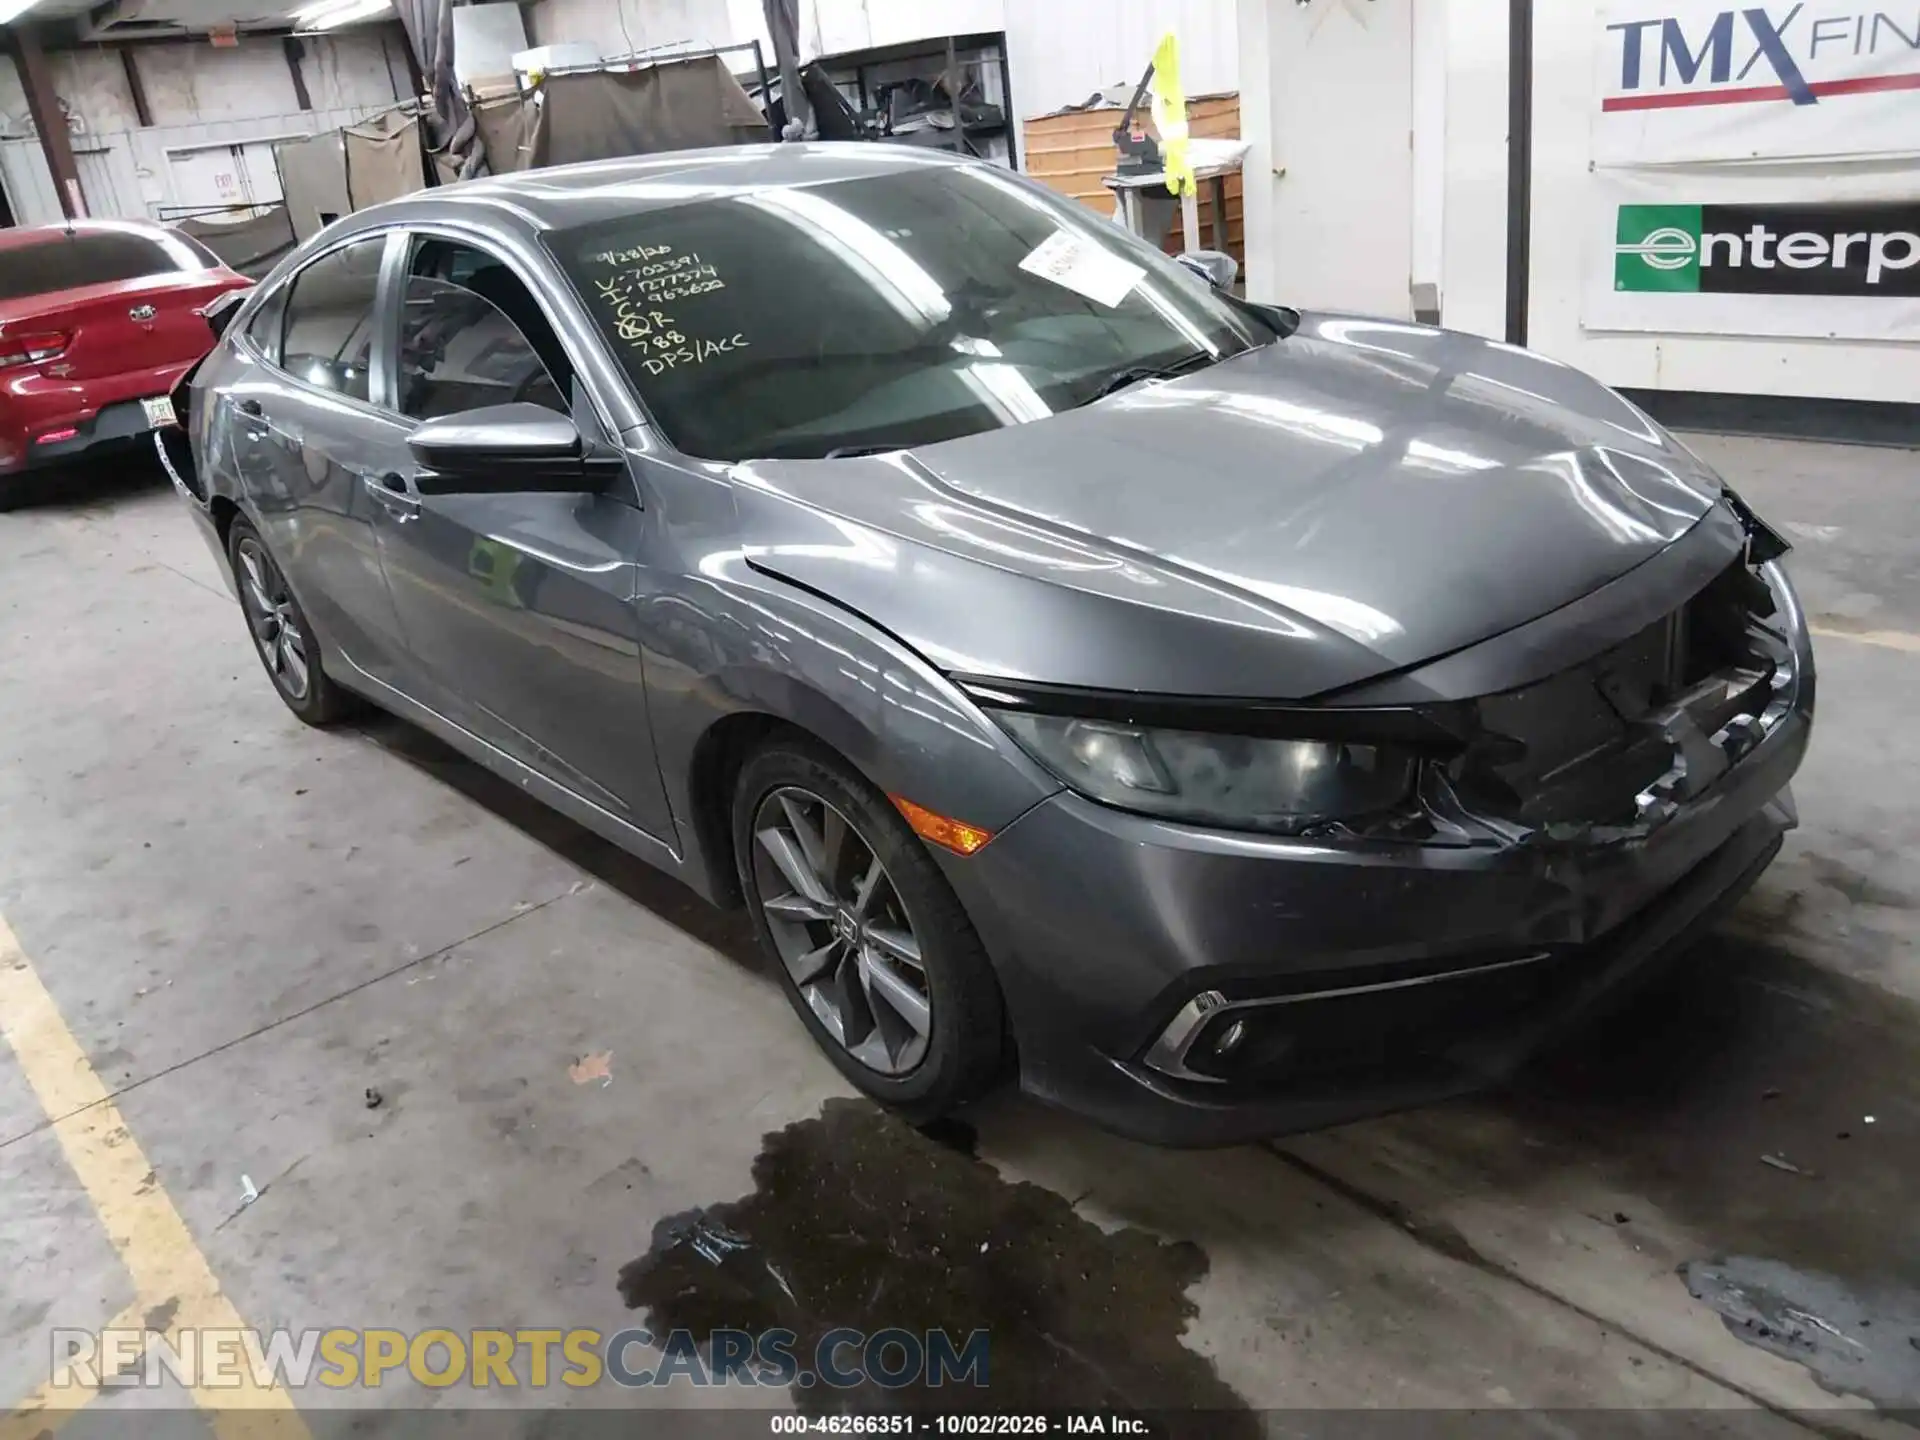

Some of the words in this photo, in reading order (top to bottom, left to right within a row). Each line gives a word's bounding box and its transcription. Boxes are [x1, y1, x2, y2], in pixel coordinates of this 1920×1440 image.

[1606, 3, 1819, 106] TMX
[1810, 13, 1920, 59] FIN
[1615, 225, 1920, 284] enterp
[631, 330, 685, 354] 788
[641, 333, 750, 375] DPS/ACC
